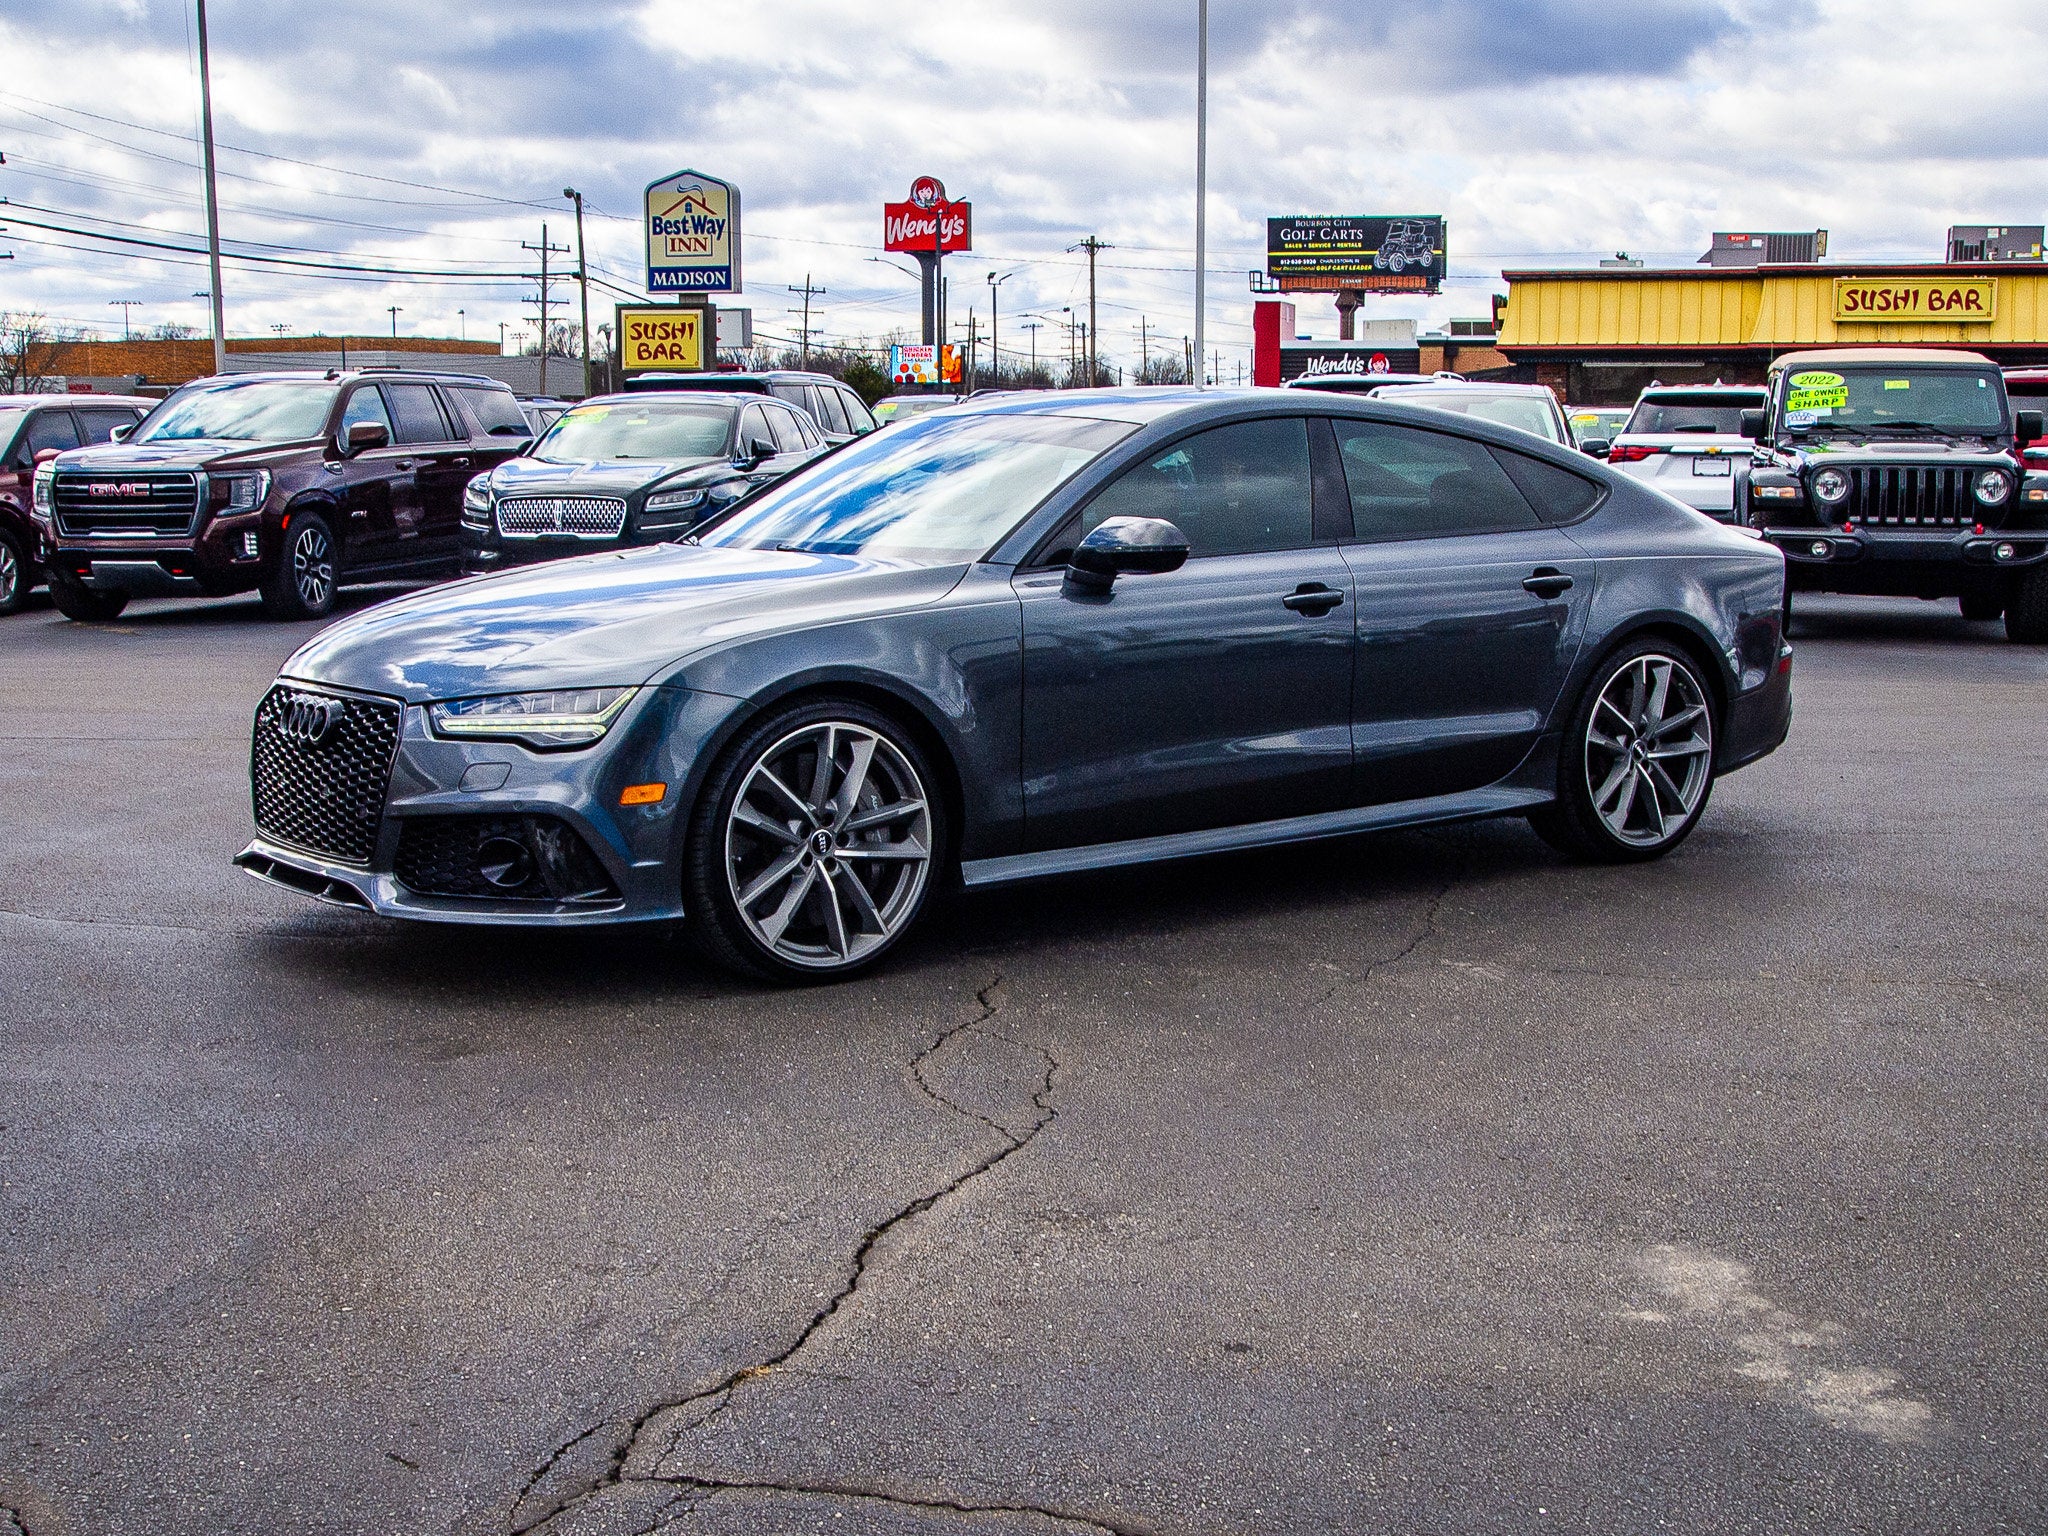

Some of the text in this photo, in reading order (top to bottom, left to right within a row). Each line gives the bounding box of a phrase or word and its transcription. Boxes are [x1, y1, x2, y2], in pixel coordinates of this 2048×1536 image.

[652, 214, 727, 241] Best Way
[1295, 218, 1352, 228] BOURBON CITY
[1280, 228, 1364, 241] GOLF CARTS
[669, 237, 708, 252] INN
[653, 271, 727, 286] MADISON
[1844, 288, 1984, 311] SUSHI BAR
[629, 322, 695, 341] SUSHI
[637, 342, 686, 360] BAR
[1307, 352, 1365, 374] Wendy's
[1799, 375, 1835, 385] 2022
[1792, 387, 1846, 399] ONE OWNER
[1794, 398, 1839, 409] SHARP
[89, 483, 150, 497] GMC
